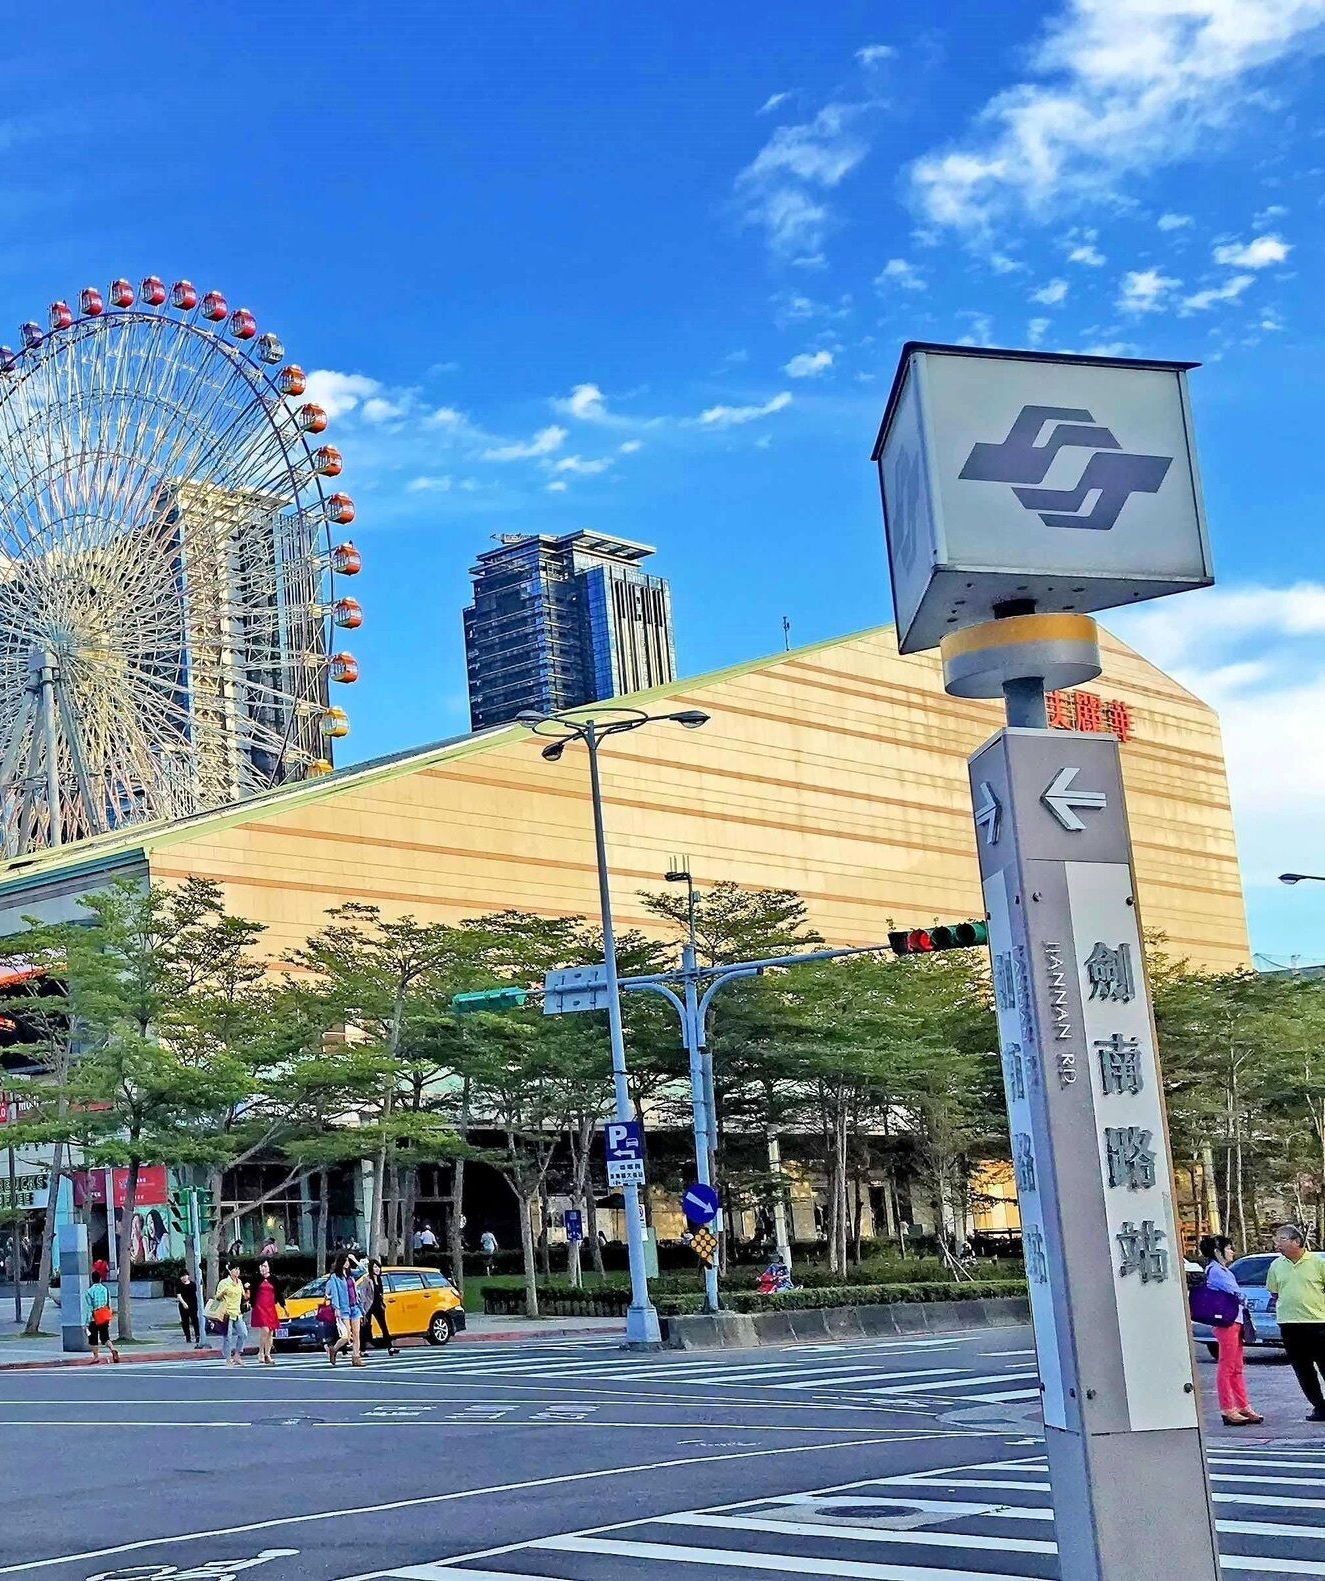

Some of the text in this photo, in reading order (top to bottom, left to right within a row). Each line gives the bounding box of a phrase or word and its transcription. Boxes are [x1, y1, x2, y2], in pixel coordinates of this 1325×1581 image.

[1042, 940, 1077, 1086] JIANNAN RD
[609, 1126, 627, 1149] P
[1084, 941, 1169, 1285] 劍南路站
